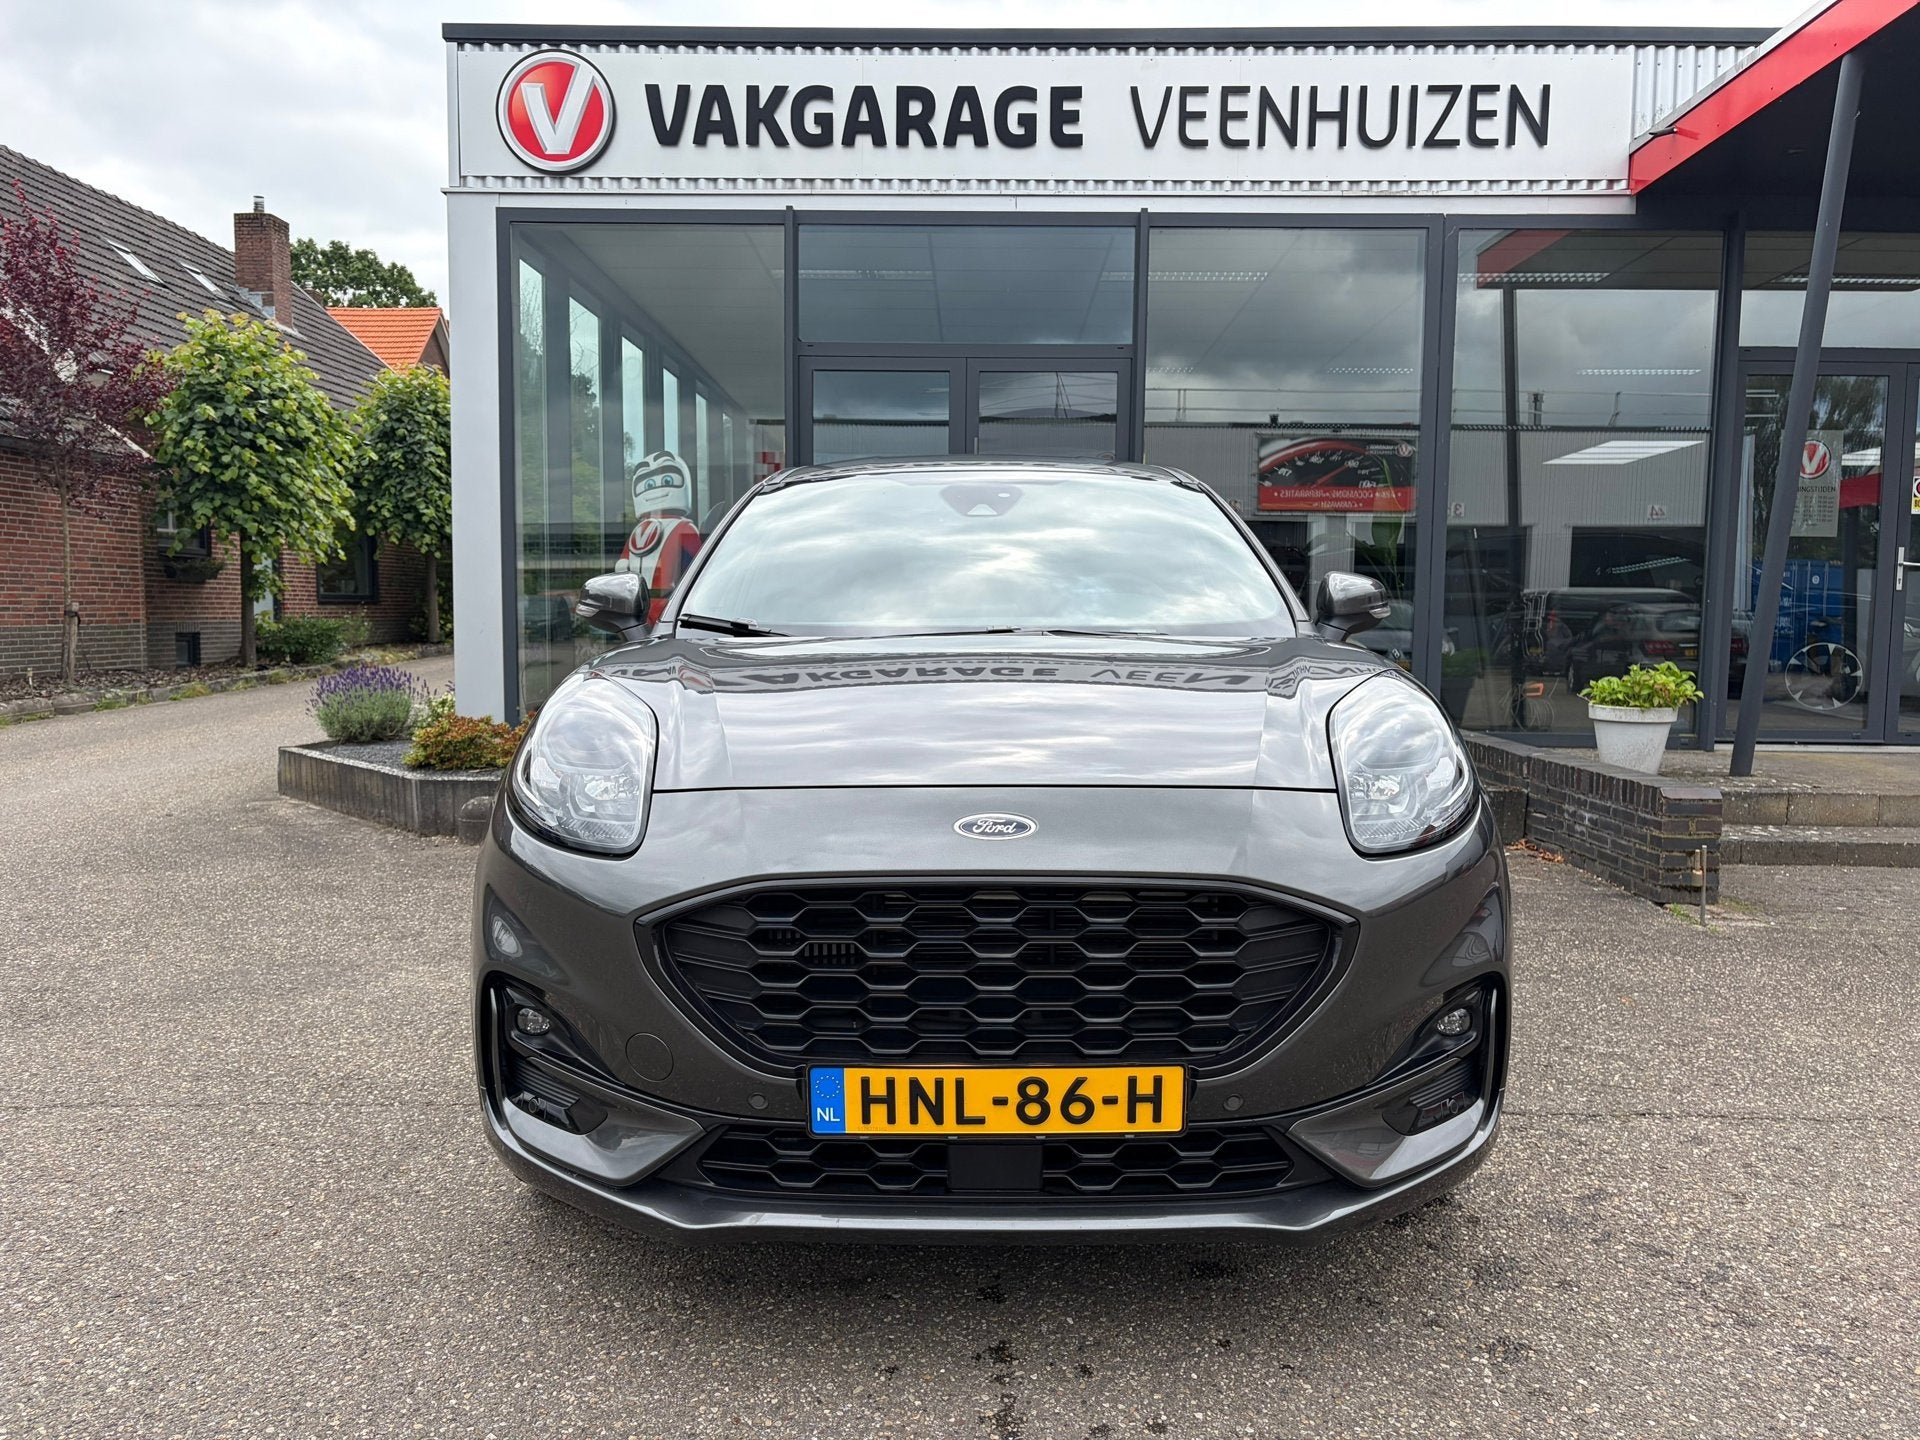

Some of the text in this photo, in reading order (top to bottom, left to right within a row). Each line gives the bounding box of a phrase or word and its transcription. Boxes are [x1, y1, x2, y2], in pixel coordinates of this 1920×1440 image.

[521, 64, 598, 155] V
[645, 83, 1551, 149] VAKGARAGE VEENHUIZEN
[1798, 485, 1836, 493] INGSTIJDEN
[972, 818, 1017, 834] Ford
[816, 1074, 1163, 1126] NL HNL-86-H
